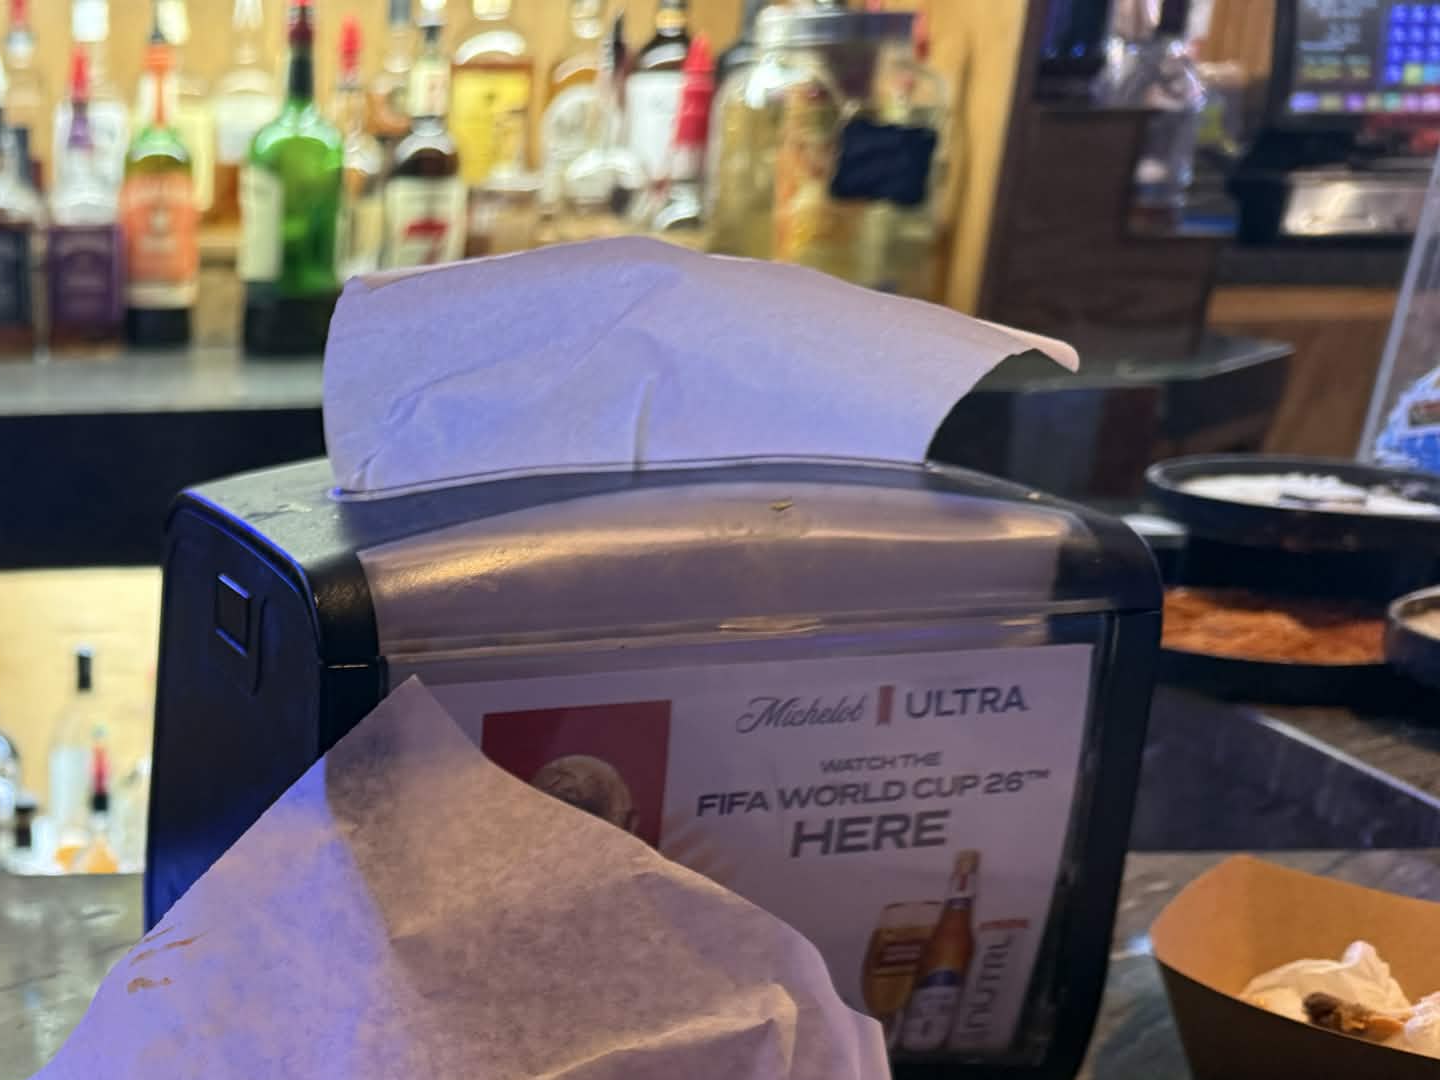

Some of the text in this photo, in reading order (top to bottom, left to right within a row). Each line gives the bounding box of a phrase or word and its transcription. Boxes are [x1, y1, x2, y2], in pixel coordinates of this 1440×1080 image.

[906, 685, 1030, 719] ULTRA
[819, 751, 942, 774] WATCH THE
[696, 791, 769, 816] FIFA
[776, 779, 905, 809] WORLD
[912, 773, 979, 799] CUP
[789, 809, 951, 858] HERE
